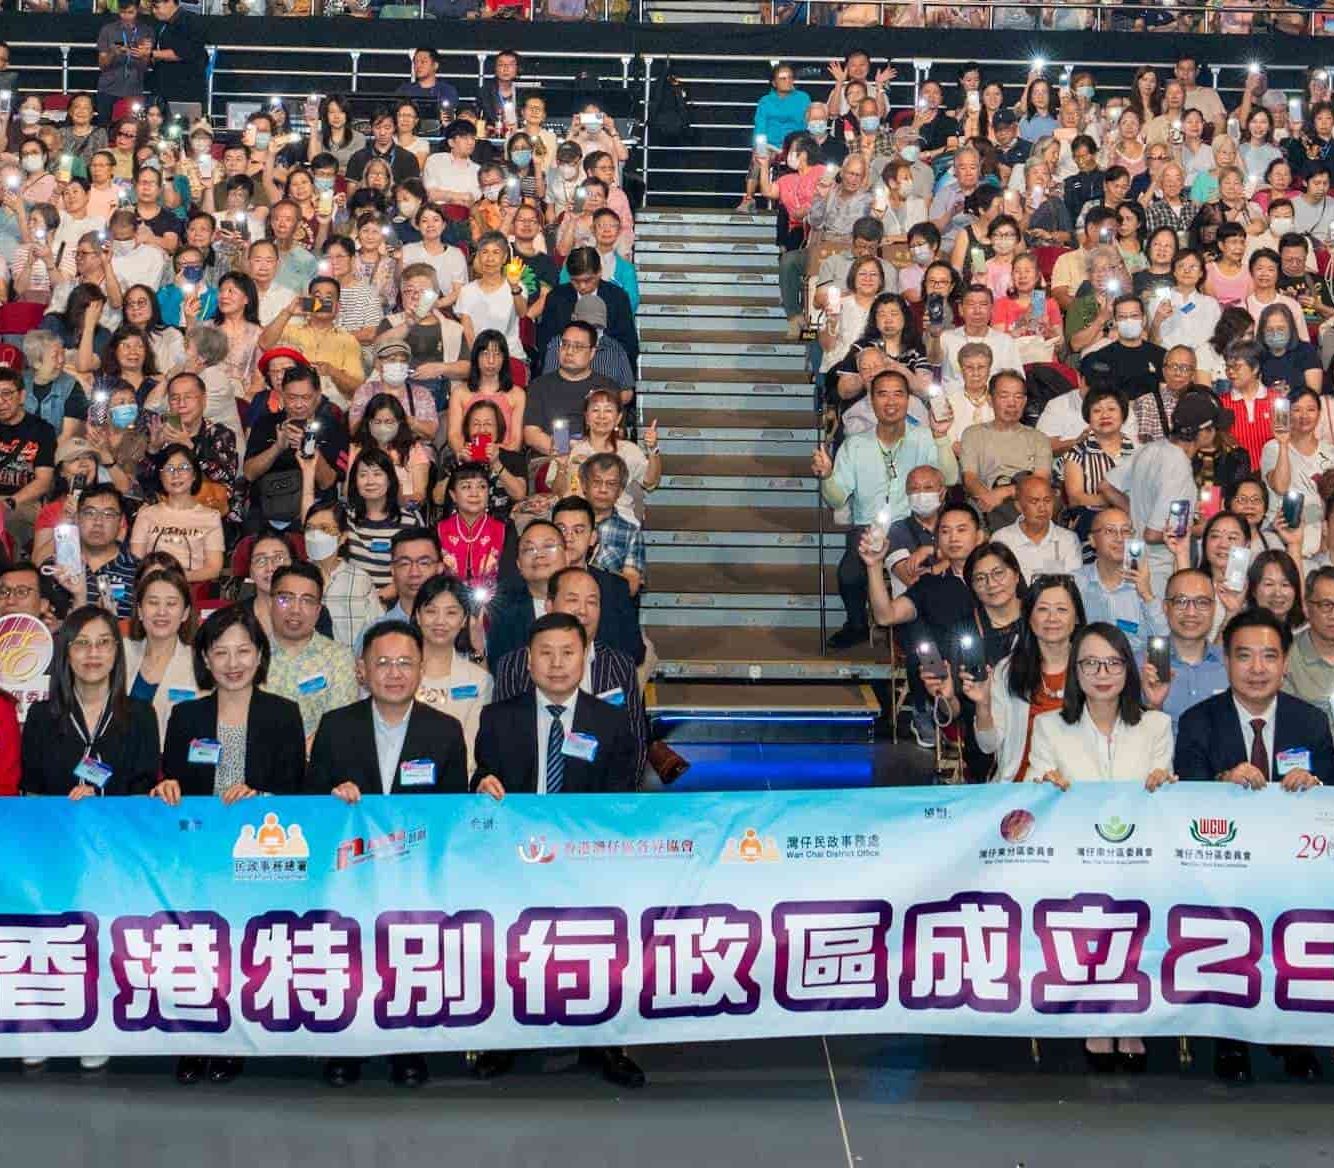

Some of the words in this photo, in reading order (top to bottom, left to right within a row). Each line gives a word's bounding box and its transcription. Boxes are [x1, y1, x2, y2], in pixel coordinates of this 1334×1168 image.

[1199, 818, 1228, 835] WCW
[786, 850, 804, 859] Wan
[806, 850, 824, 858] Chai
[826, 849, 854, 858] District
[857, 849, 880, 857] Office
